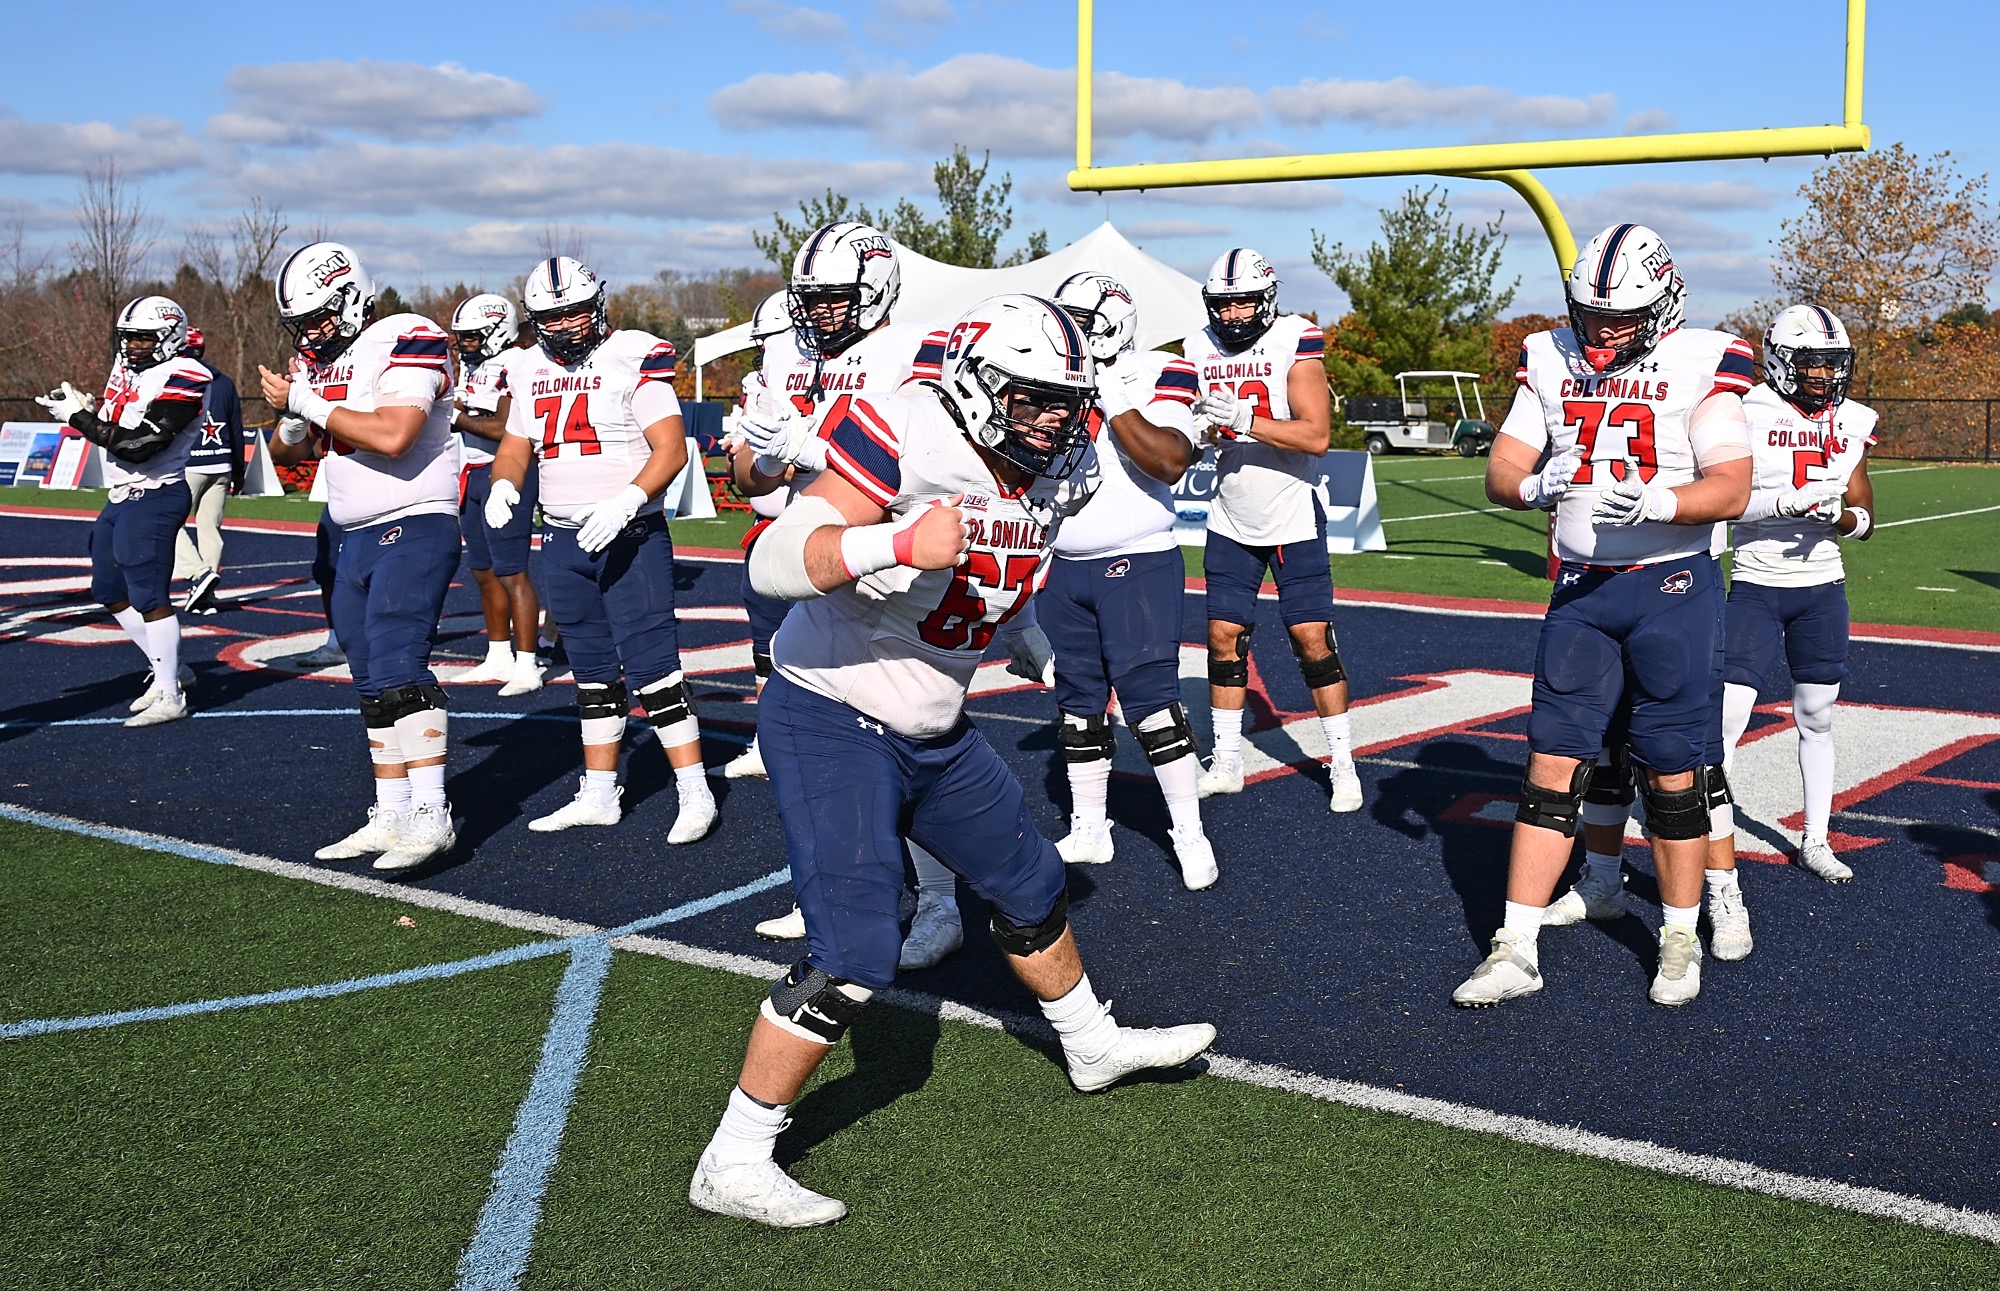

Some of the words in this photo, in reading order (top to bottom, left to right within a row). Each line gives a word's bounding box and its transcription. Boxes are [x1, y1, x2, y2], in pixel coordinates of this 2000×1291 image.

[850, 235, 892, 259] RMU
[307, 250, 350, 289] RMU
[479, 303, 508, 317] RMU
[1590, 299, 1612, 307] UNITE
[946, 321, 992, 360] 67
[785, 372, 867, 391] COLNIALS
[1065, 372, 1087, 382] UNITE
[1203, 362, 1272, 380] COLONIALS
[532, 375, 602, 396] COLONIALS
[1560, 377, 1669, 401] COLONIALS
[534, 393, 602, 459] 74
[1562, 400, 1659, 485] 73
[964, 494, 990, 507] NEC
[967, 518, 1050, 549] OLONIALS
[917, 550, 1041, 650] 67
